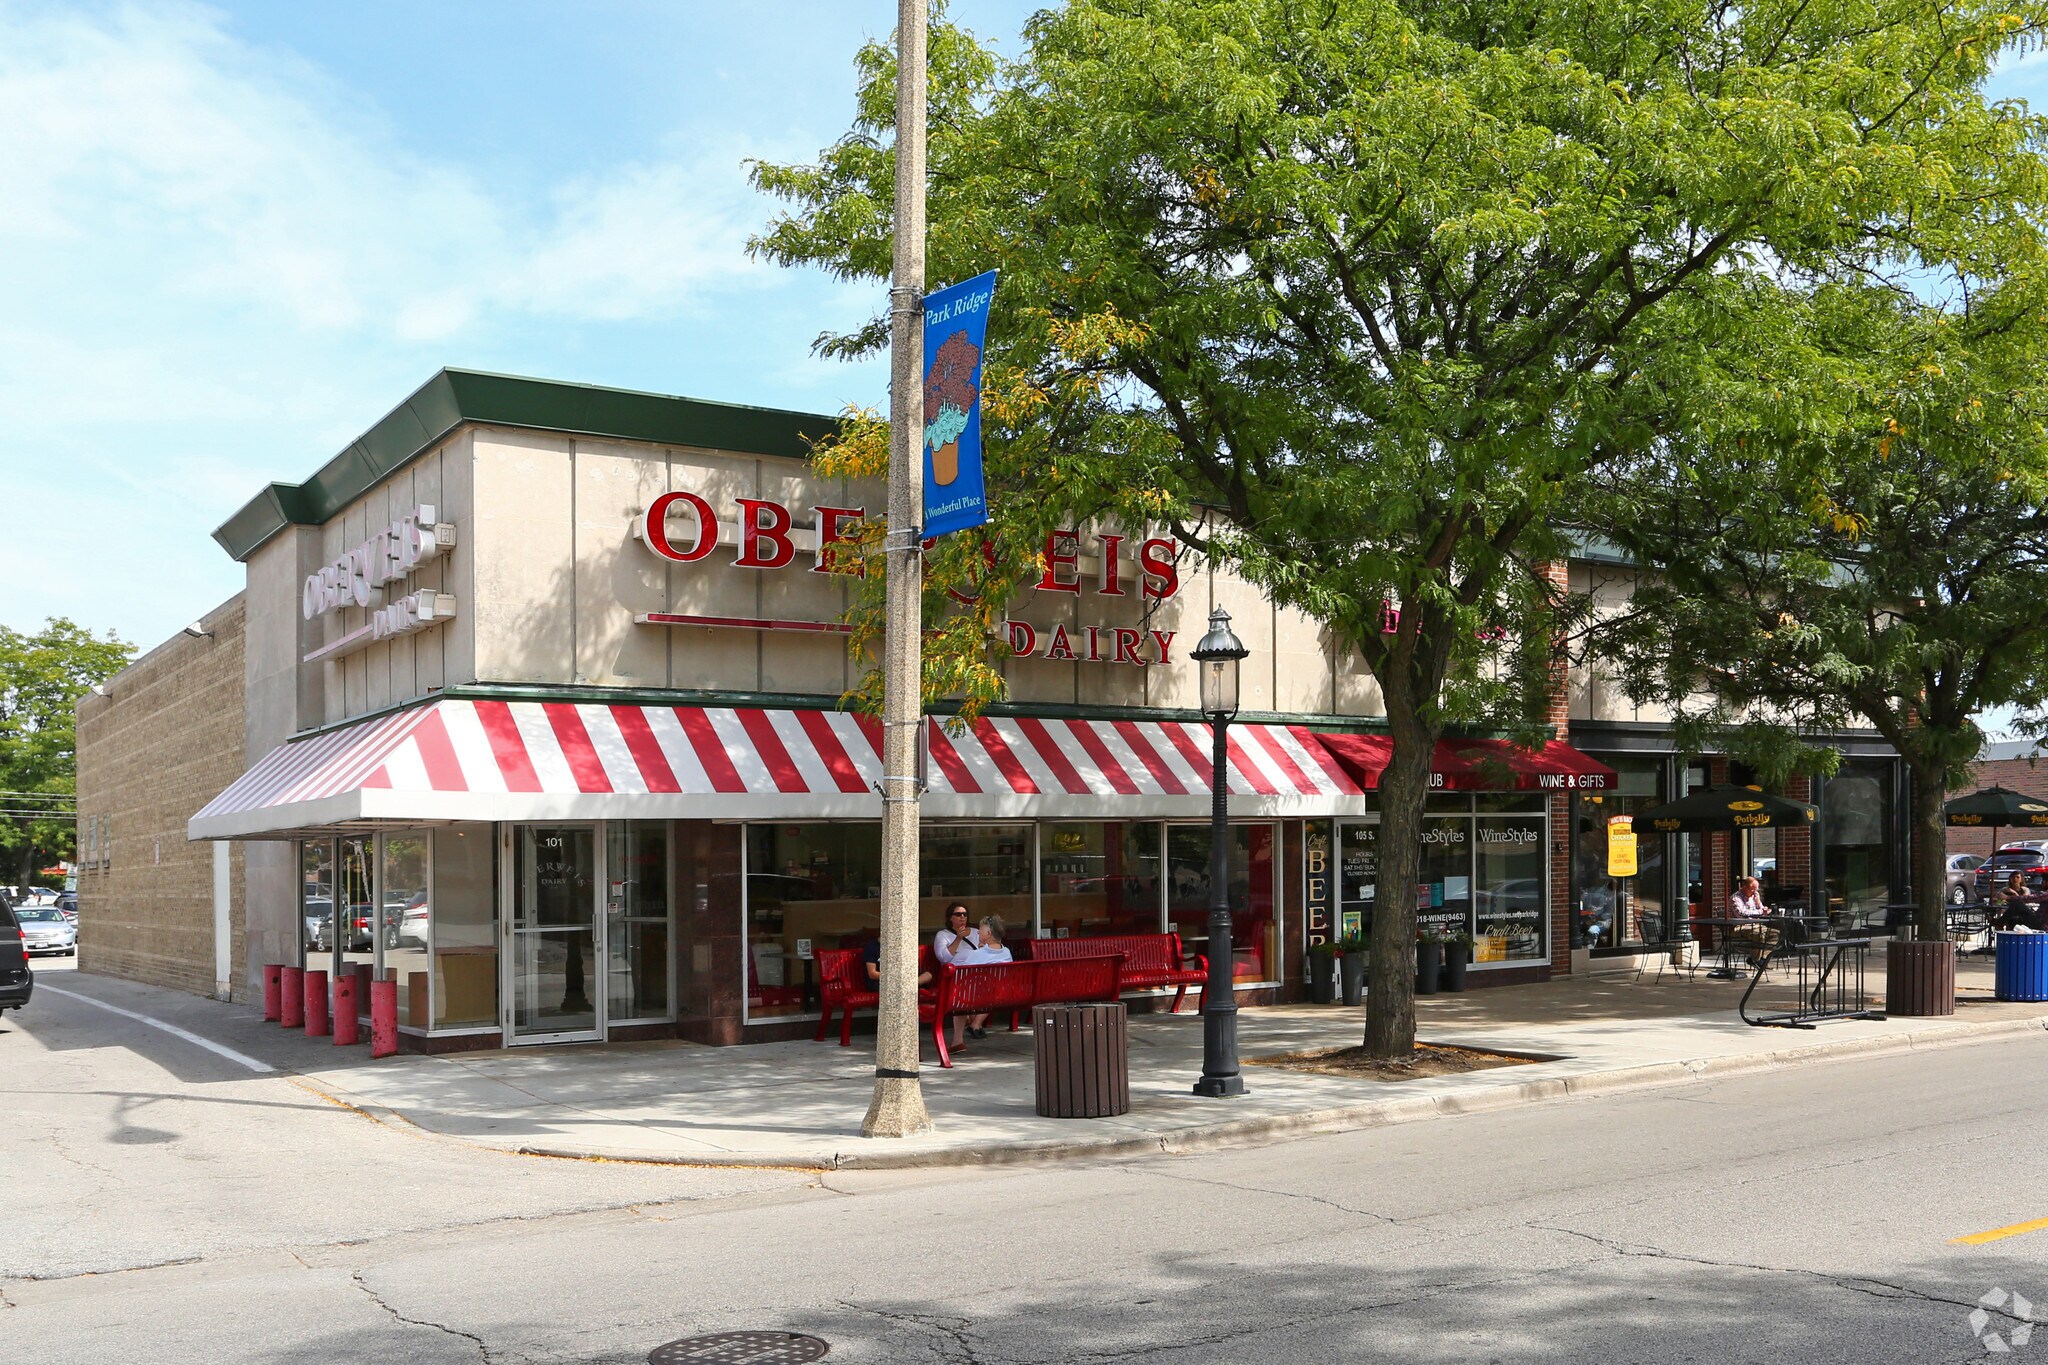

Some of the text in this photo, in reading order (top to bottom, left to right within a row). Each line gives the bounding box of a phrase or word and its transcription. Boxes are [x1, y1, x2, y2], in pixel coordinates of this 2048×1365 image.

[925, 289, 989, 328] Park Ridge
[927, 495, 981, 521] Wonderful Place
[641, 491, 1180, 602] OBEEIS
[1006, 619, 1178, 667] DAIRY
[1429, 774, 1444, 787] UB
[1539, 774, 1605, 788] WINE & GIFTS
[1733, 813, 1771, 826] Potbelly
[545, 837, 563, 847] 101
[1355, 830, 1367, 840] 105
[1420, 828, 1465, 846] neStyles
[1478, 828, 1538, 846] WineStyles
[1484, 923, 1534, 938] Craft Beer
